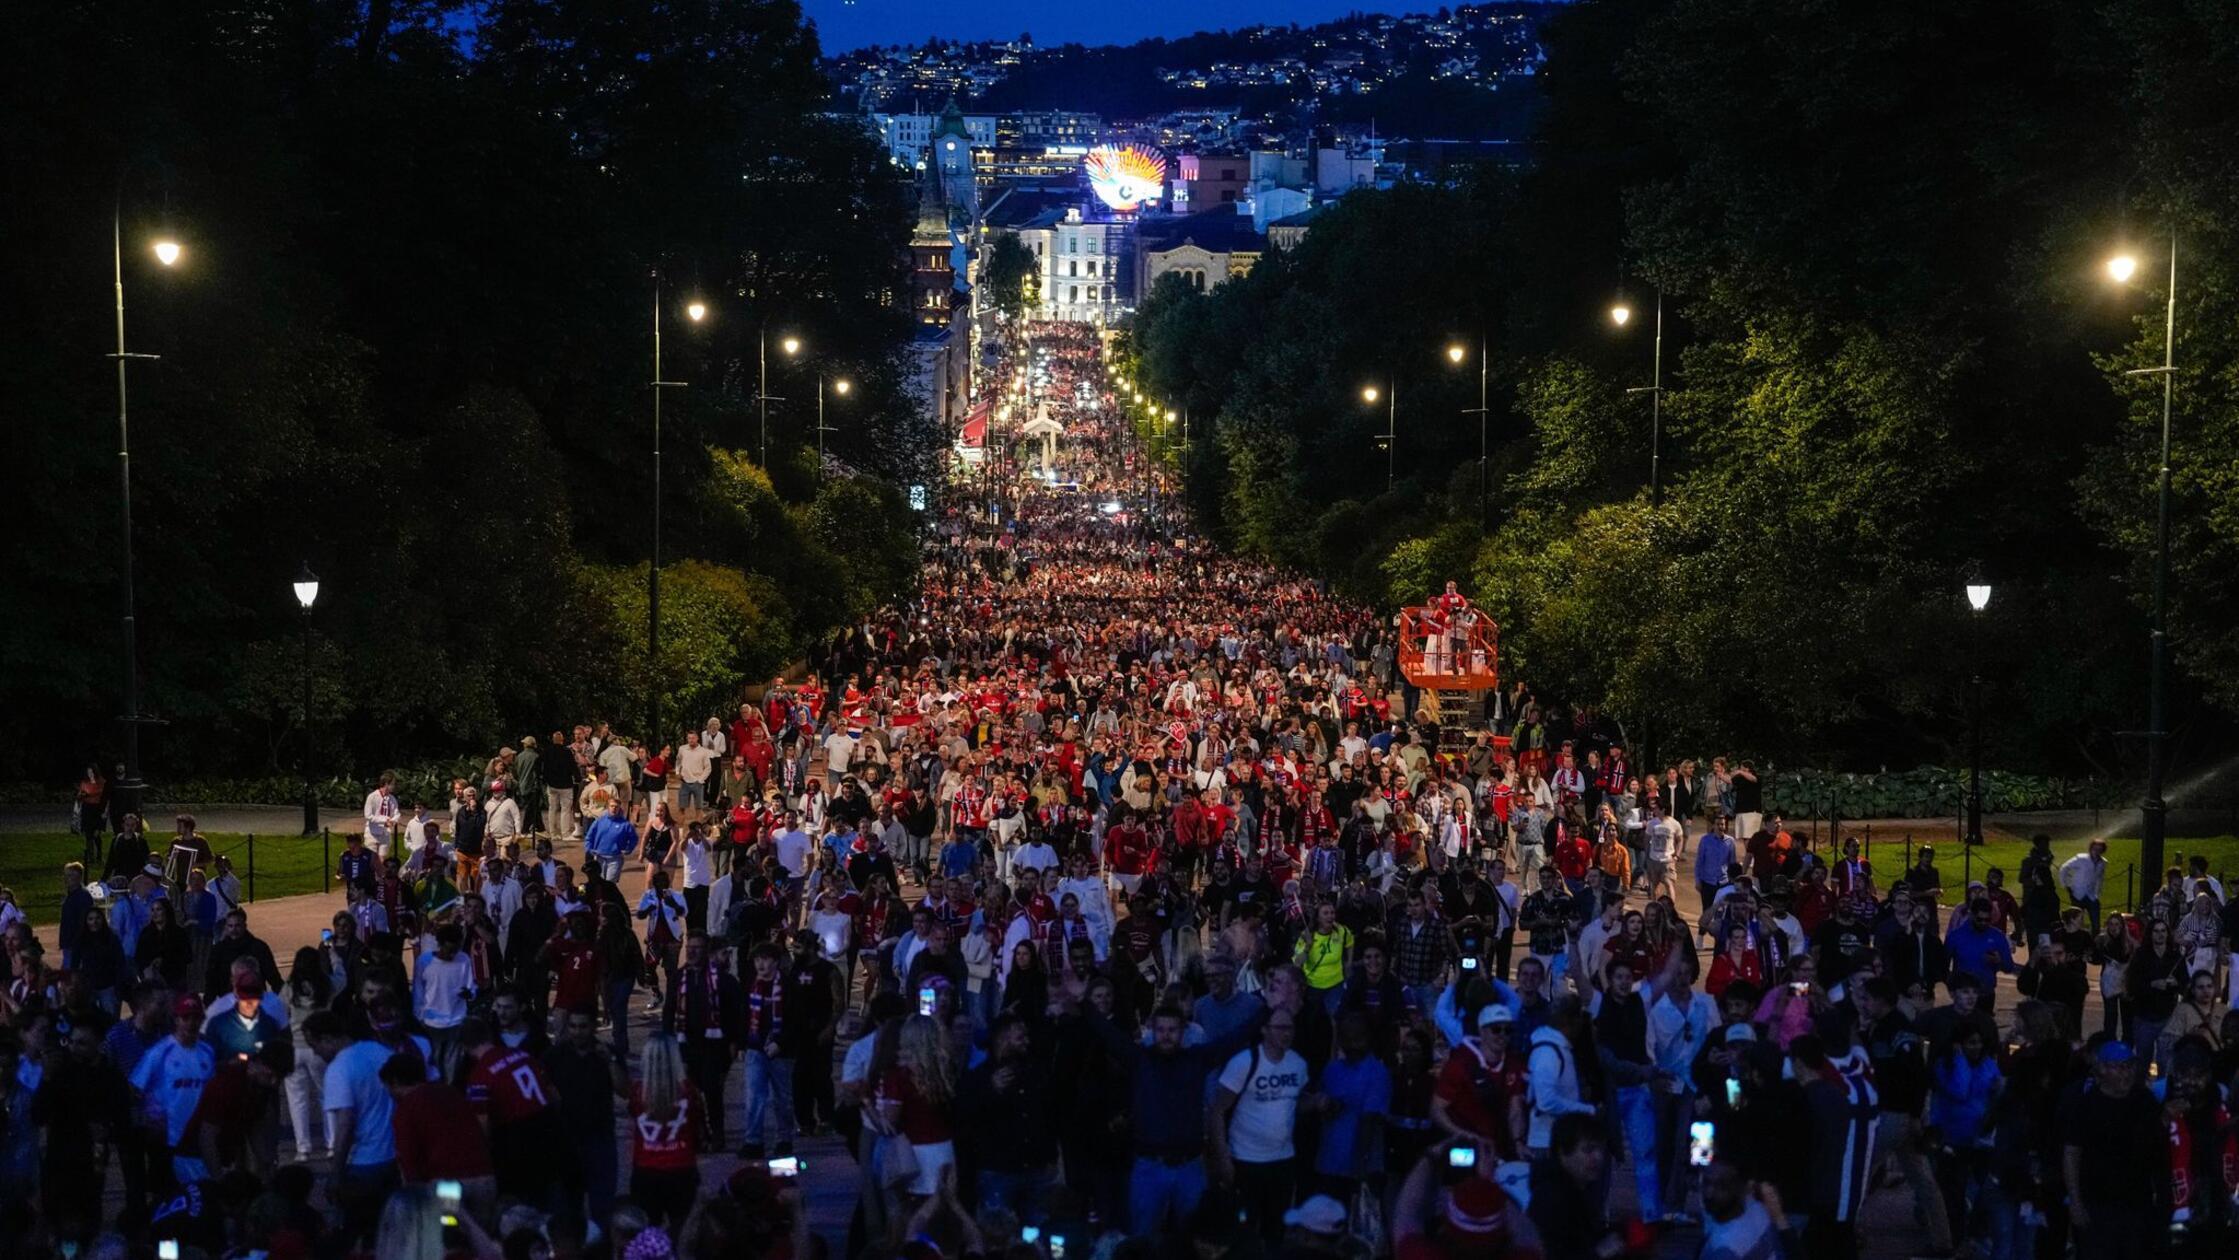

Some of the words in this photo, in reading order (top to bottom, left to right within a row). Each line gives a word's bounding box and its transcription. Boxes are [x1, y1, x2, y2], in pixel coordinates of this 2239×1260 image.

[573, 956, 581, 970] 2
[512, 1065, 547, 1106] 9
[1255, 1073, 1299, 1090] CORE
